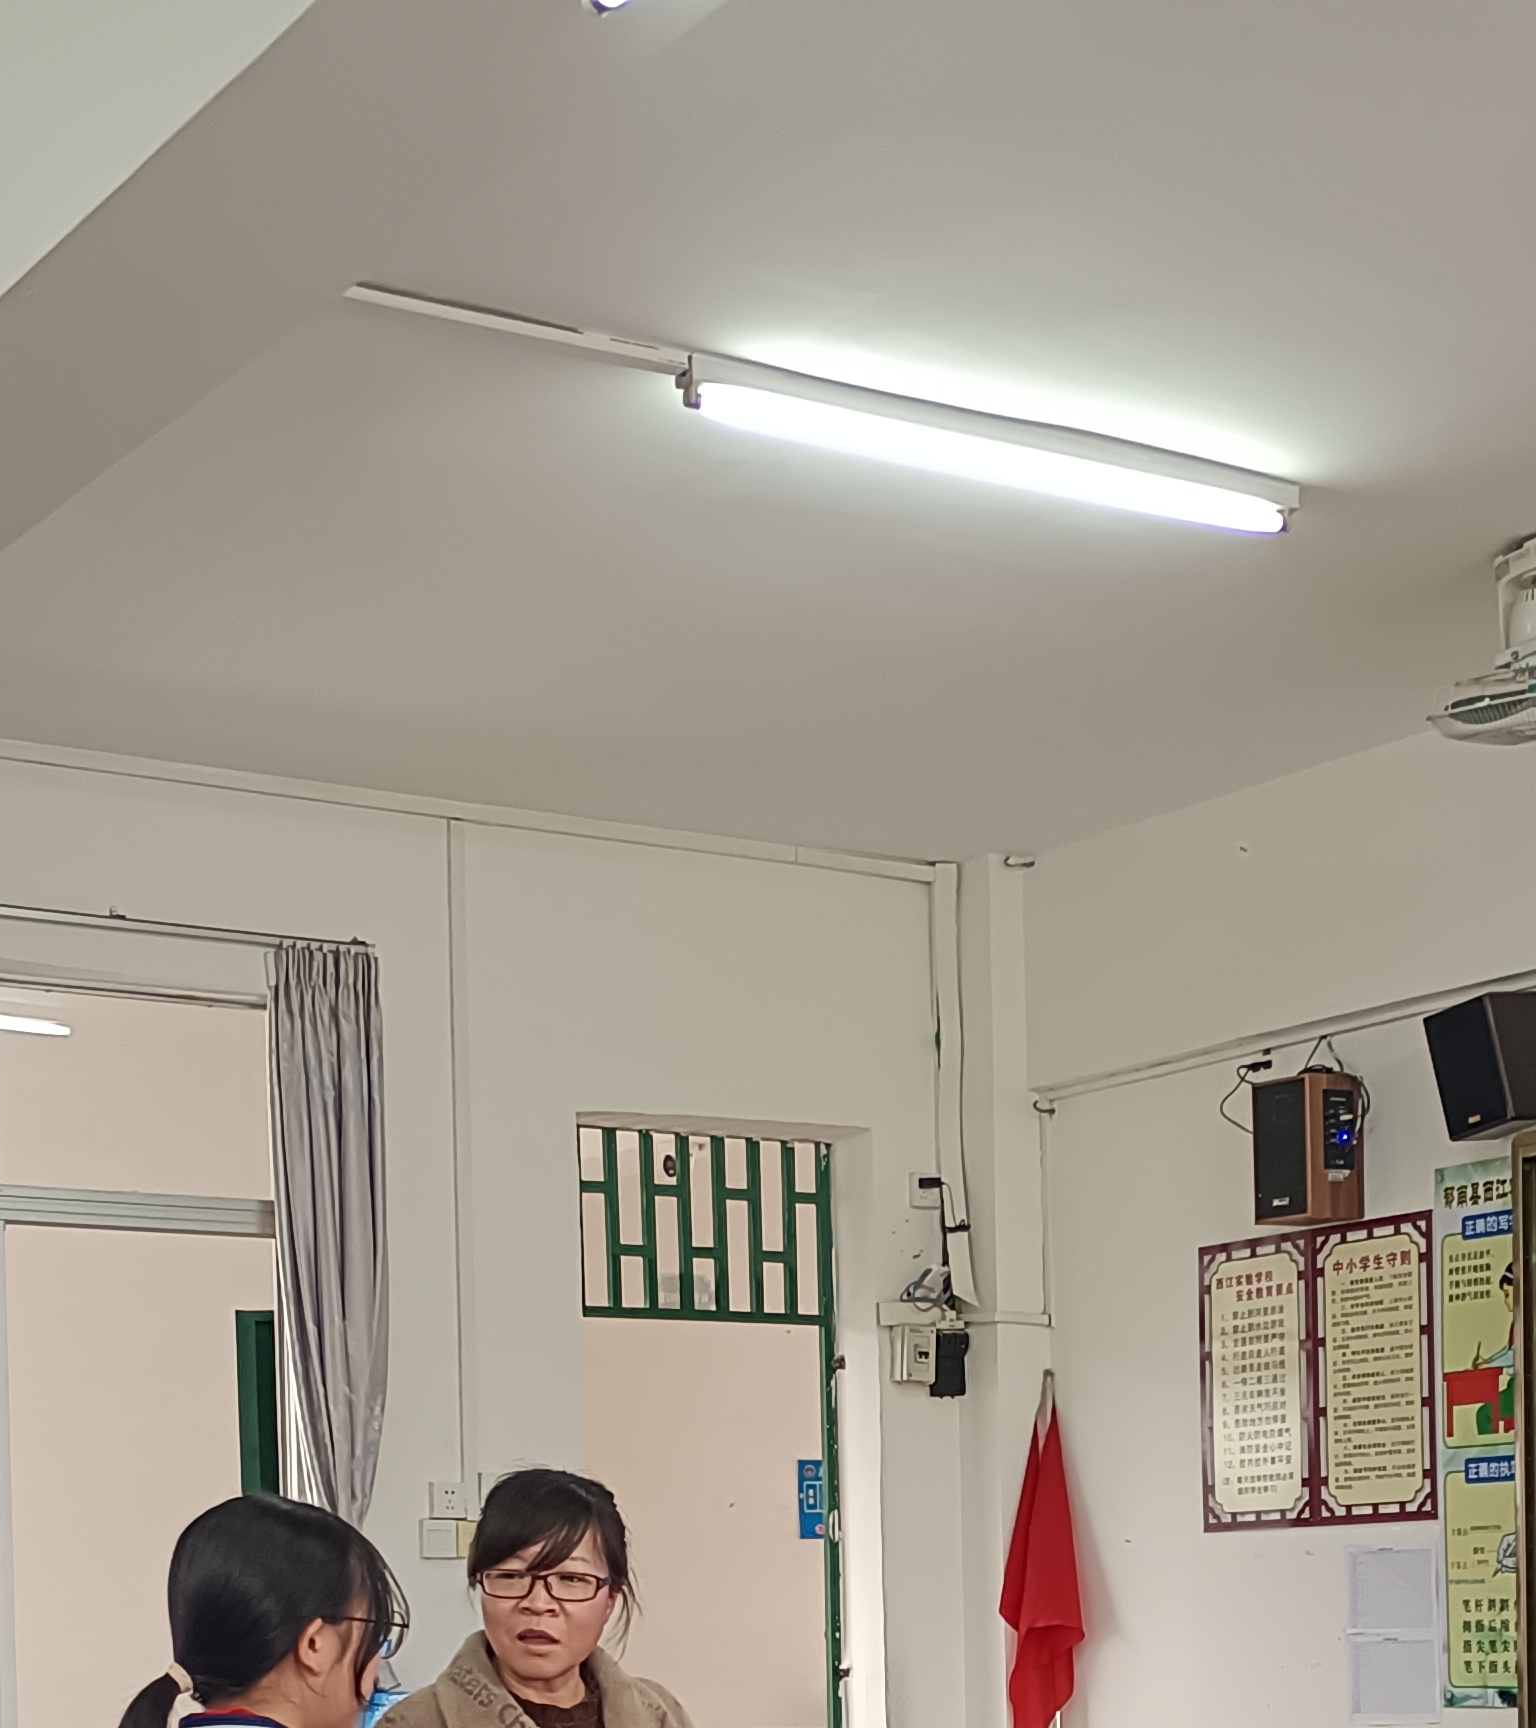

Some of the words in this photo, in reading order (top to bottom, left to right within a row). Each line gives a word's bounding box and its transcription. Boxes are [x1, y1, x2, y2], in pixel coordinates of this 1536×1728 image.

[1464, 1215, 1513, 1236] 正确的写
[1332, 1249, 1411, 1276] 中小学生守则
